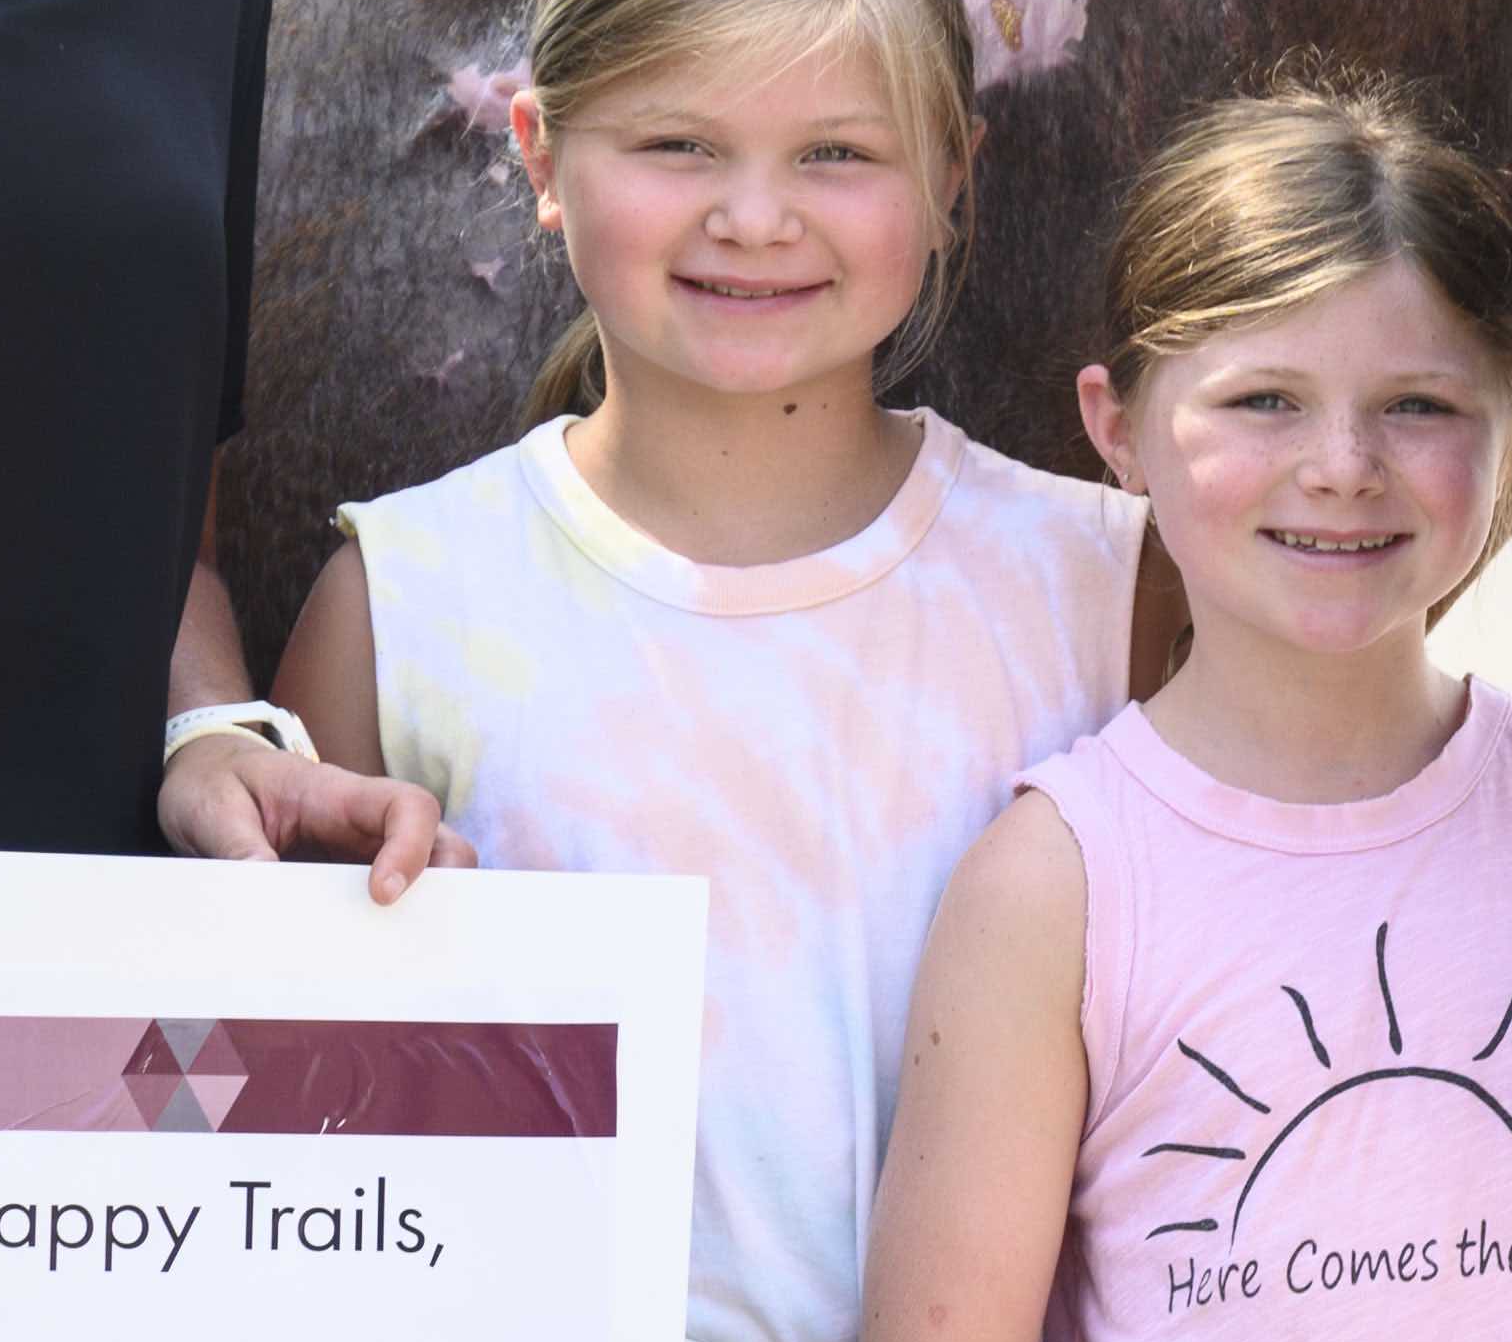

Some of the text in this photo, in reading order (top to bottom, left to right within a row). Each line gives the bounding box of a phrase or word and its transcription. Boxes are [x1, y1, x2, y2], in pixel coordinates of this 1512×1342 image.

[229, 1176, 445, 1270] Trails,
[1168, 1257, 1261, 1313] Here
[1286, 1238, 1439, 1294] Comes
